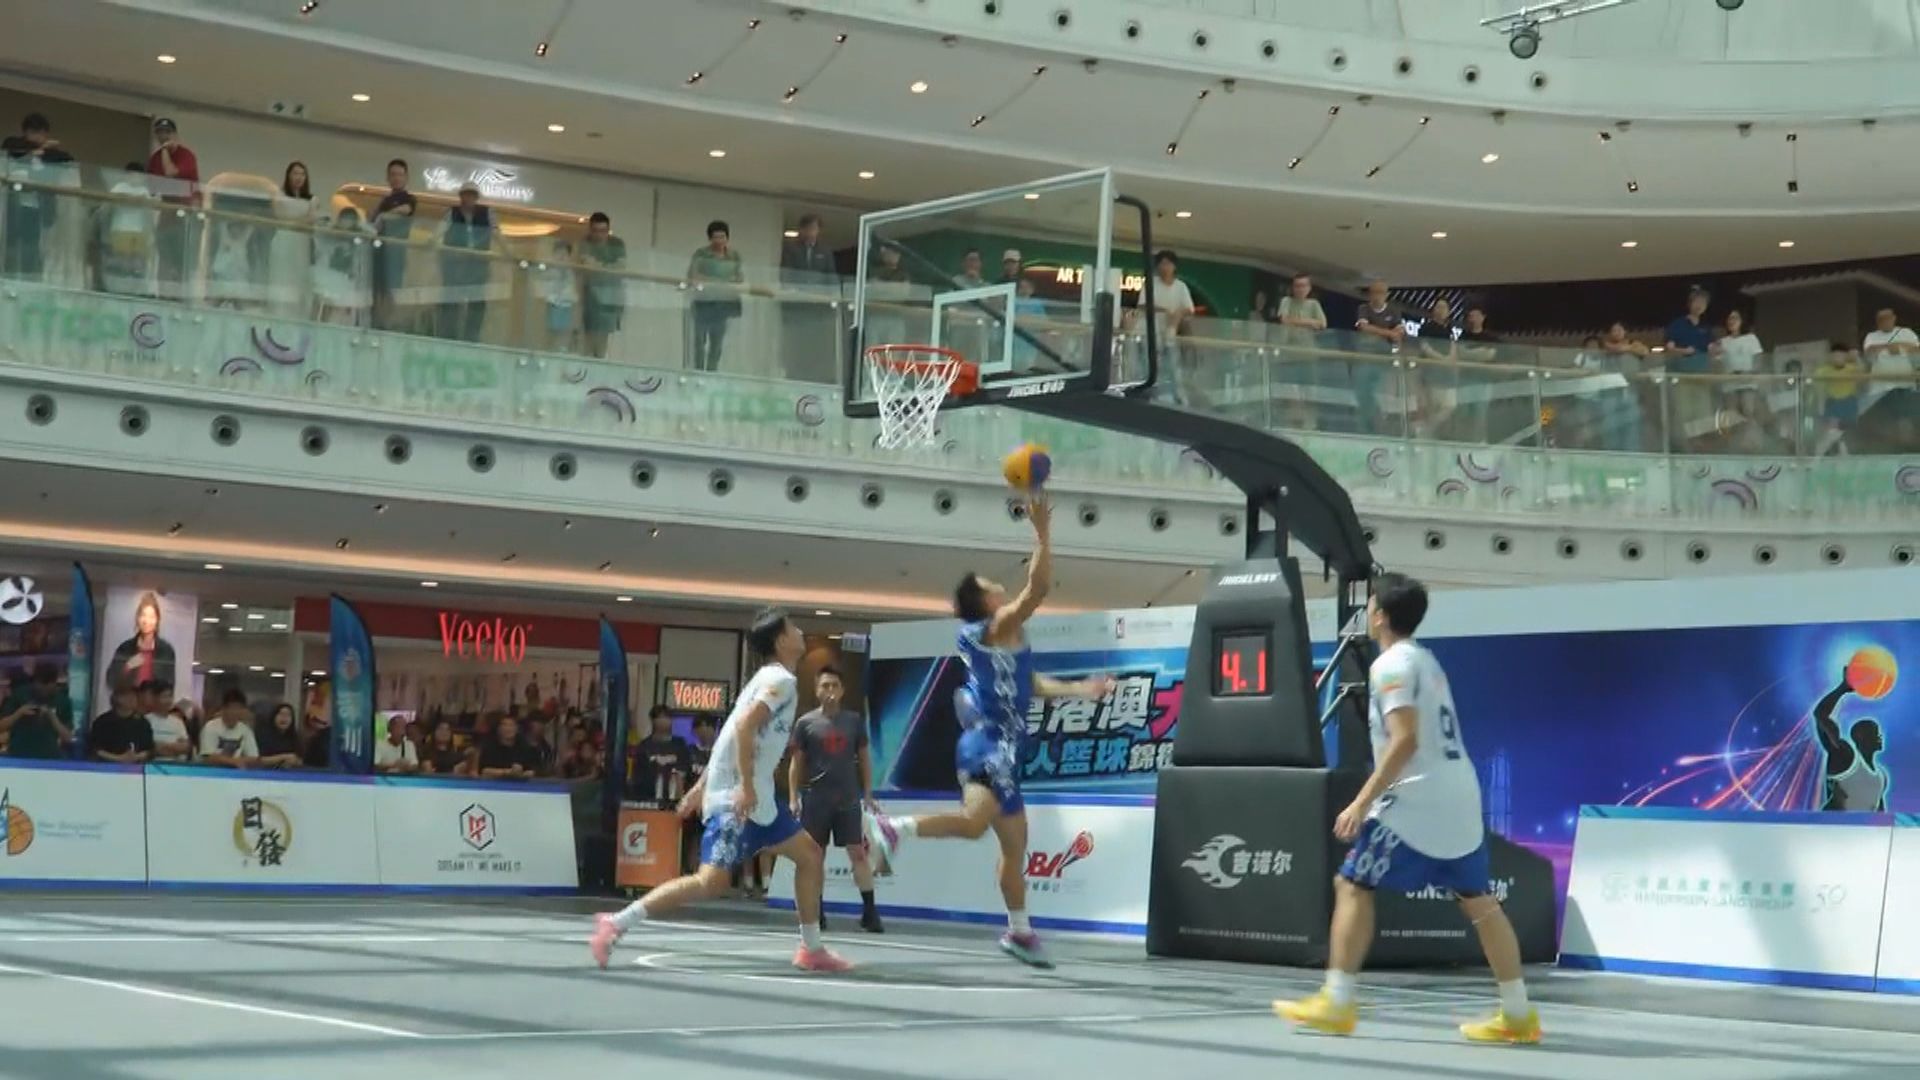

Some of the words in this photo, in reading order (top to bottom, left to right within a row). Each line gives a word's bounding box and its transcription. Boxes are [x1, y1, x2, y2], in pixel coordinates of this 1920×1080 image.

[439, 611, 527, 667] Veeko
[1222, 650, 1266, 692] 4.1
[673, 680, 721, 709] Veeko
